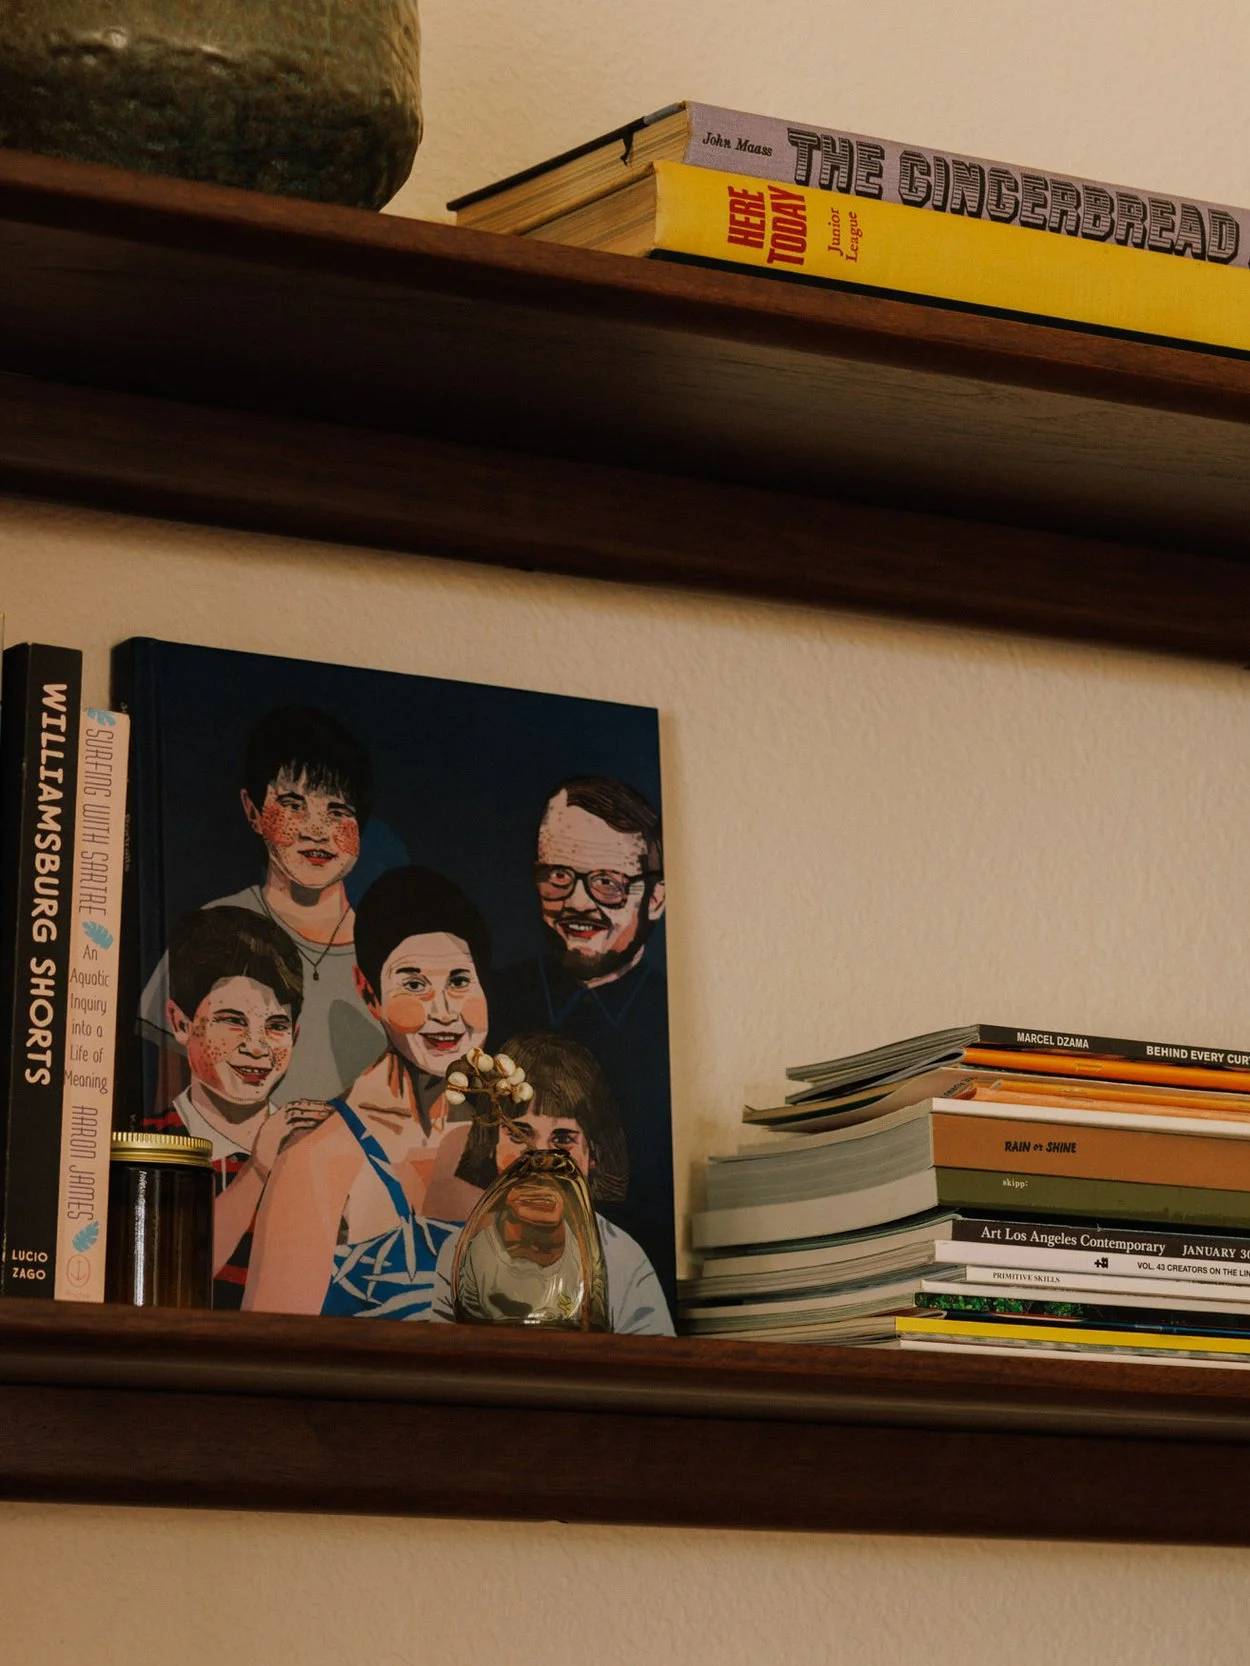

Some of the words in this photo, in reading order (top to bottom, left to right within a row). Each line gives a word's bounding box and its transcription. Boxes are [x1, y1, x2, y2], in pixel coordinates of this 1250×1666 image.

[702, 131, 731, 149] John
[735, 137, 773, 157] Maass
[787, 127, 886, 200] THE
[898, 149, 1240, 266] GINGERBREAD
[727, 185, 766, 249] HERE
[767, 185, 808, 266] TODAY
[827, 207, 844, 256] Junior
[845, 210, 863, 263] League
[84, 728, 114, 798] SURFING
[31, 684, 67, 943] WILLIAMSBURG
[82, 803, 110, 845] WITH
[79, 850, 109, 916] SARTRE
[83, 945, 98, 961] An
[70, 968, 110, 988] Aquatic
[70, 993, 107, 1016] Inquiry
[25, 957, 56, 1085] SHORTS
[71, 1020, 92, 1036] into
[96, 1027, 103, 1037] a
[70, 1045, 89, 1062] Life
[93, 1048, 104, 1063] of
[1017, 1031, 1055, 1045] MARCEL
[1056, 1036, 1089, 1048] DZAMA
[1146, 1045, 1188, 1059] BEHIND
[1190, 1050, 1224, 1063] EVERY
[65, 1070, 108, 1094] Meaning
[70, 1105, 98, 1160] AARON
[1004, 1141, 1031, 1152] RAIN
[1033, 1143, 1043, 1152] or
[1046, 1142, 1076, 1153] SHINE
[67, 1164, 95, 1221] JAMES
[12, 1249, 48, 1263] LUCIO
[981, 1226, 1001, 1240] Art
[1005, 1229, 1027, 1242] Los
[1030, 1232, 1077, 1247] Angeles
[1080, 1234, 1165, 1256] Contemporary
[1182, 1244, 1236, 1259] JANUARY
[12, 1268, 46, 1280] ZAGO
[992, 1271, 1033, 1282] PRIMITIVE
[1033, 1274, 1060, 1283] SKILLS
[1137, 1261, 1156, 1271] VOL.
[1157, 1262, 1166, 1272] 43
[1167, 1263, 1208, 1275] CREATORS
[1209, 1267, 1221, 1276] ON
[1223, 1268, 1238, 1277] THE
